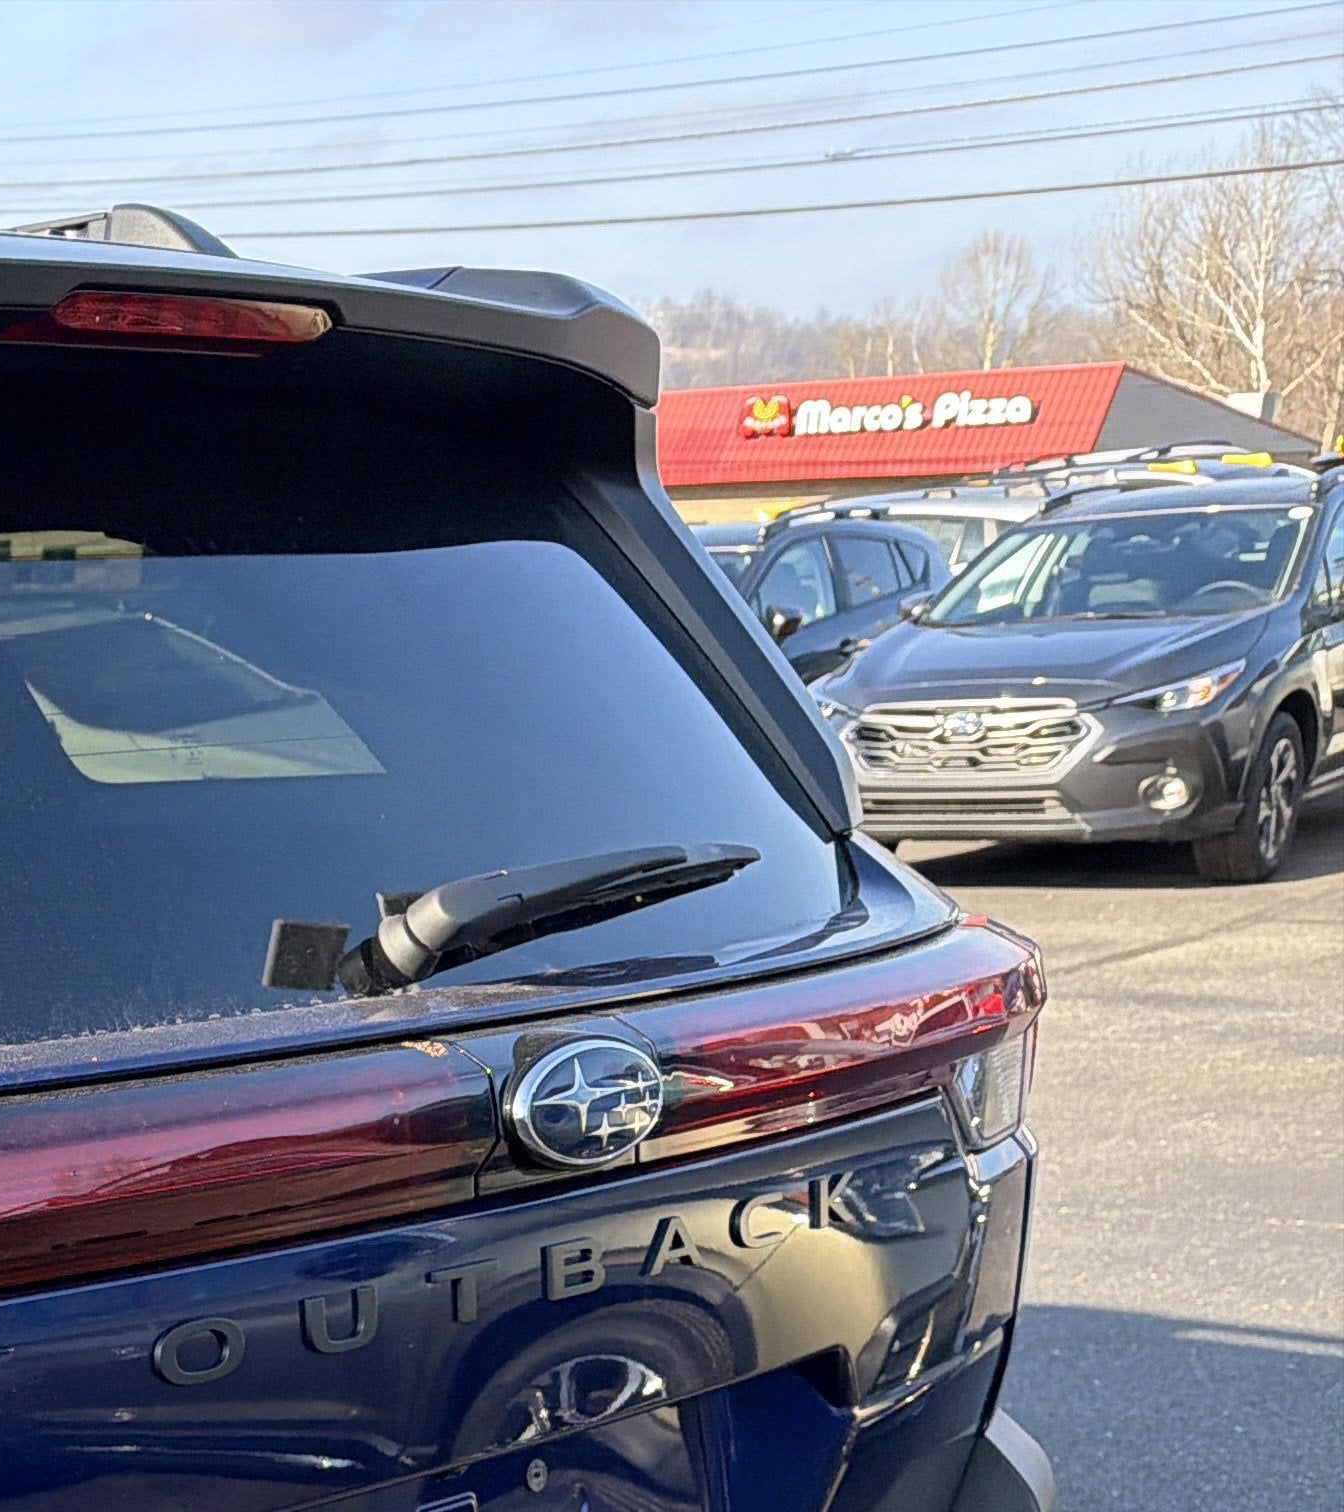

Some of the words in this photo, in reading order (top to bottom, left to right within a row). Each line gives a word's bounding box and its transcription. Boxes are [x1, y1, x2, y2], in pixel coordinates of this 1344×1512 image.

[795, 394, 924, 436] Marco's
[931, 390, 1033, 429] Pizza
[150, 1172, 855, 1387] OUTBACK
